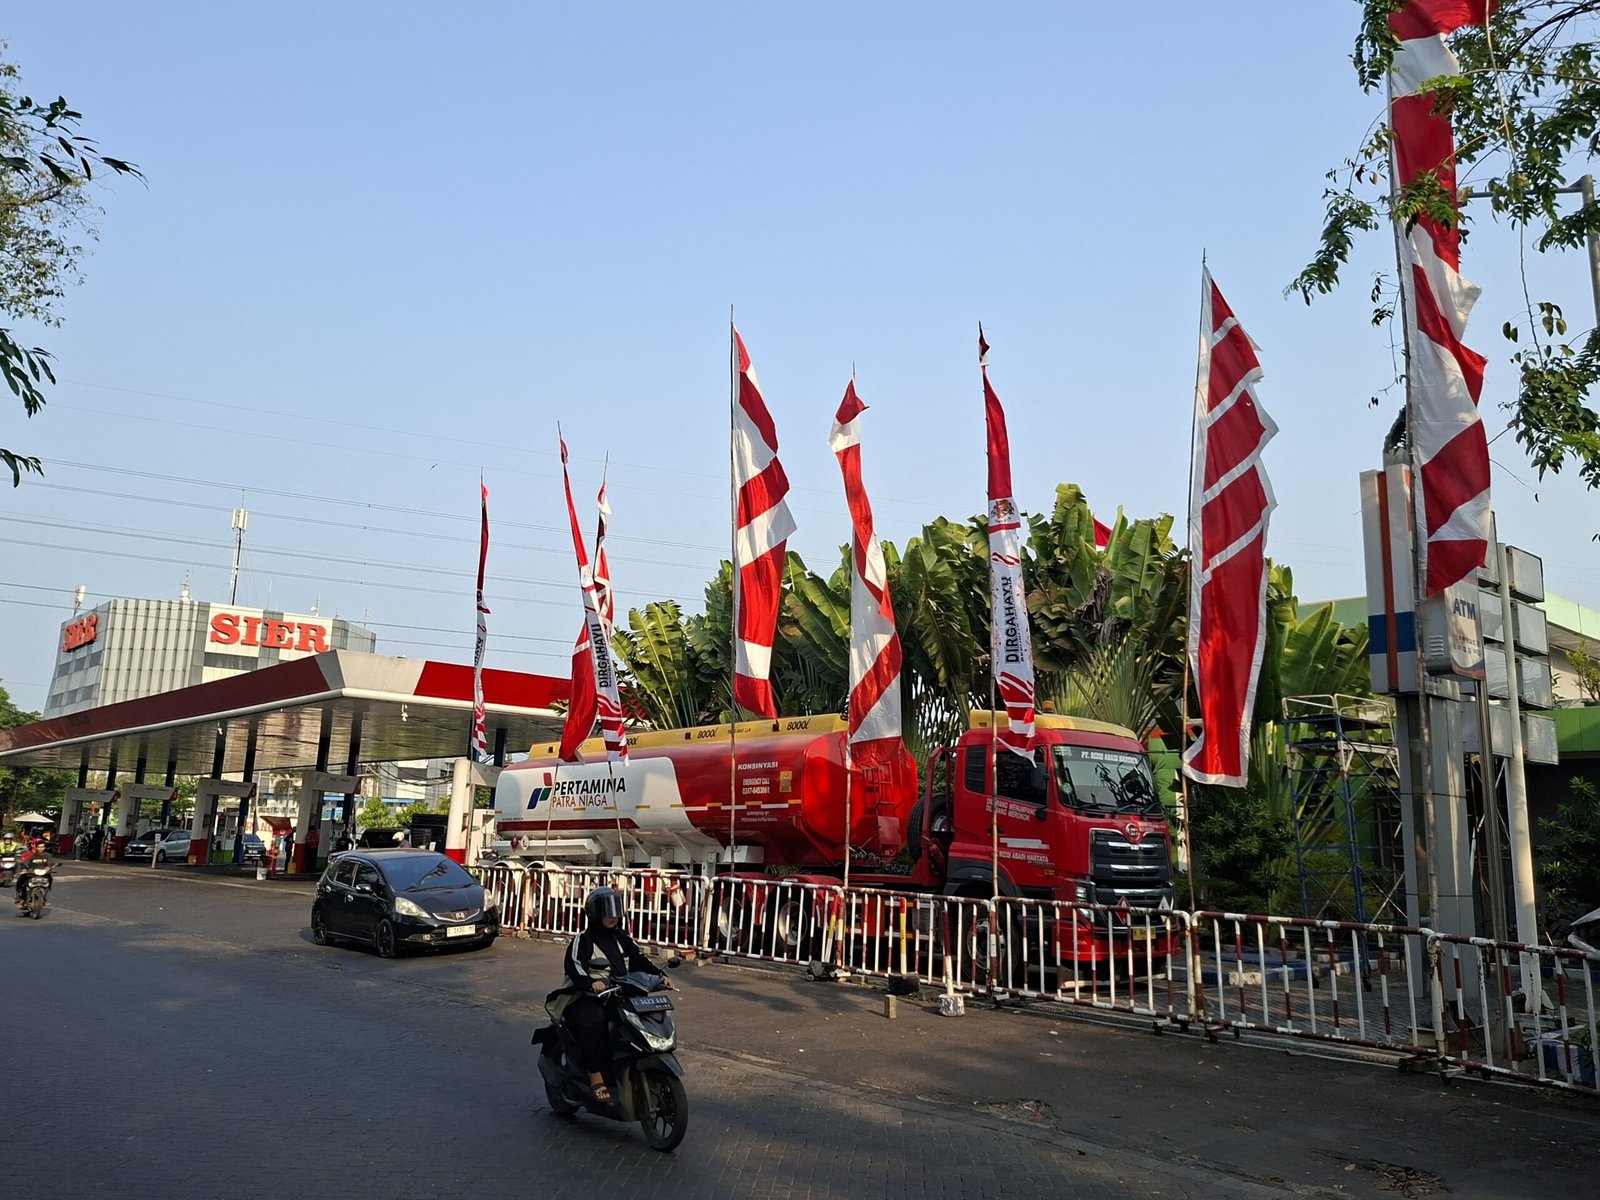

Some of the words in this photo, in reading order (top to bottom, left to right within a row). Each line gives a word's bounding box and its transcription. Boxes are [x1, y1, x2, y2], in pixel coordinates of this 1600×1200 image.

[1001, 576, 1019, 663] DIRGAHAYU
[1453, 597, 1476, 620] ATM
[62, 614, 97, 652] SIER
[210, 613, 330, 653] SIER
[591, 623, 609, 688] DIRGAHAYU
[737, 761, 779, 770] KONSINYASI
[552, 796, 575, 808] PATRA
[578, 793, 608, 807] NIAGA
[553, 777, 626, 796] PERTAMINA
